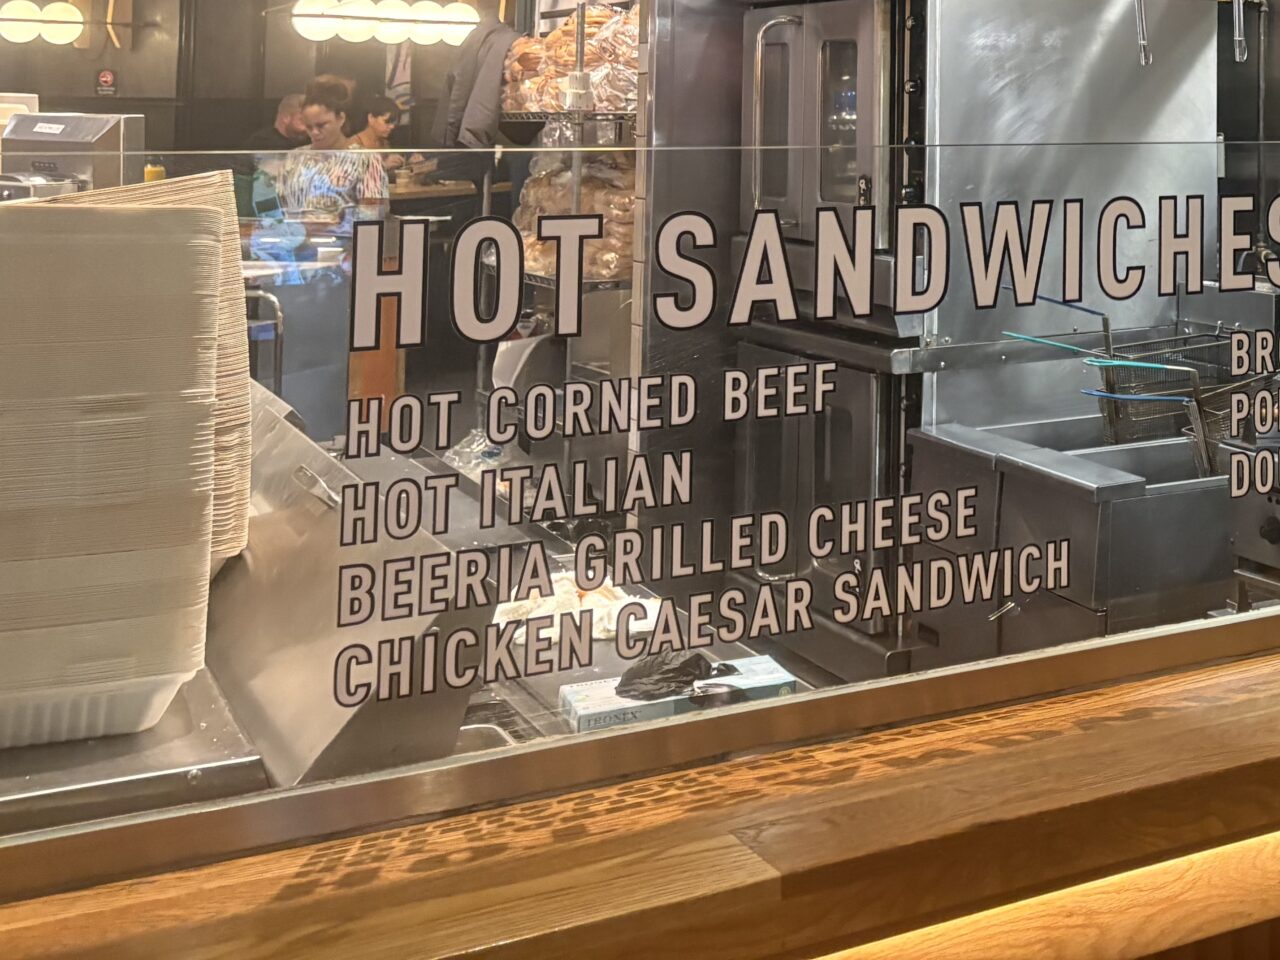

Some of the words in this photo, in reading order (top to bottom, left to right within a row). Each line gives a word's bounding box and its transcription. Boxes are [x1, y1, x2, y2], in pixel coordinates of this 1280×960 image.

[349, 213, 603, 352] HOT
[345, 390, 462, 460] HOT
[487, 373, 697, 444] CORNED
[722, 361, 838, 423] BEEF
[335, 540, 556, 628] BEERIA
[574, 510, 789, 588] GRILLED
[807, 485, 979, 560] CHEESE
[339, 474, 458, 547] HOT
[479, 450, 693, 530] ITALIAN
[332, 609, 594, 709] CHICKEN
[615, 577, 814, 660] CAESAR
[832, 539, 1071, 625] SANDWICH
